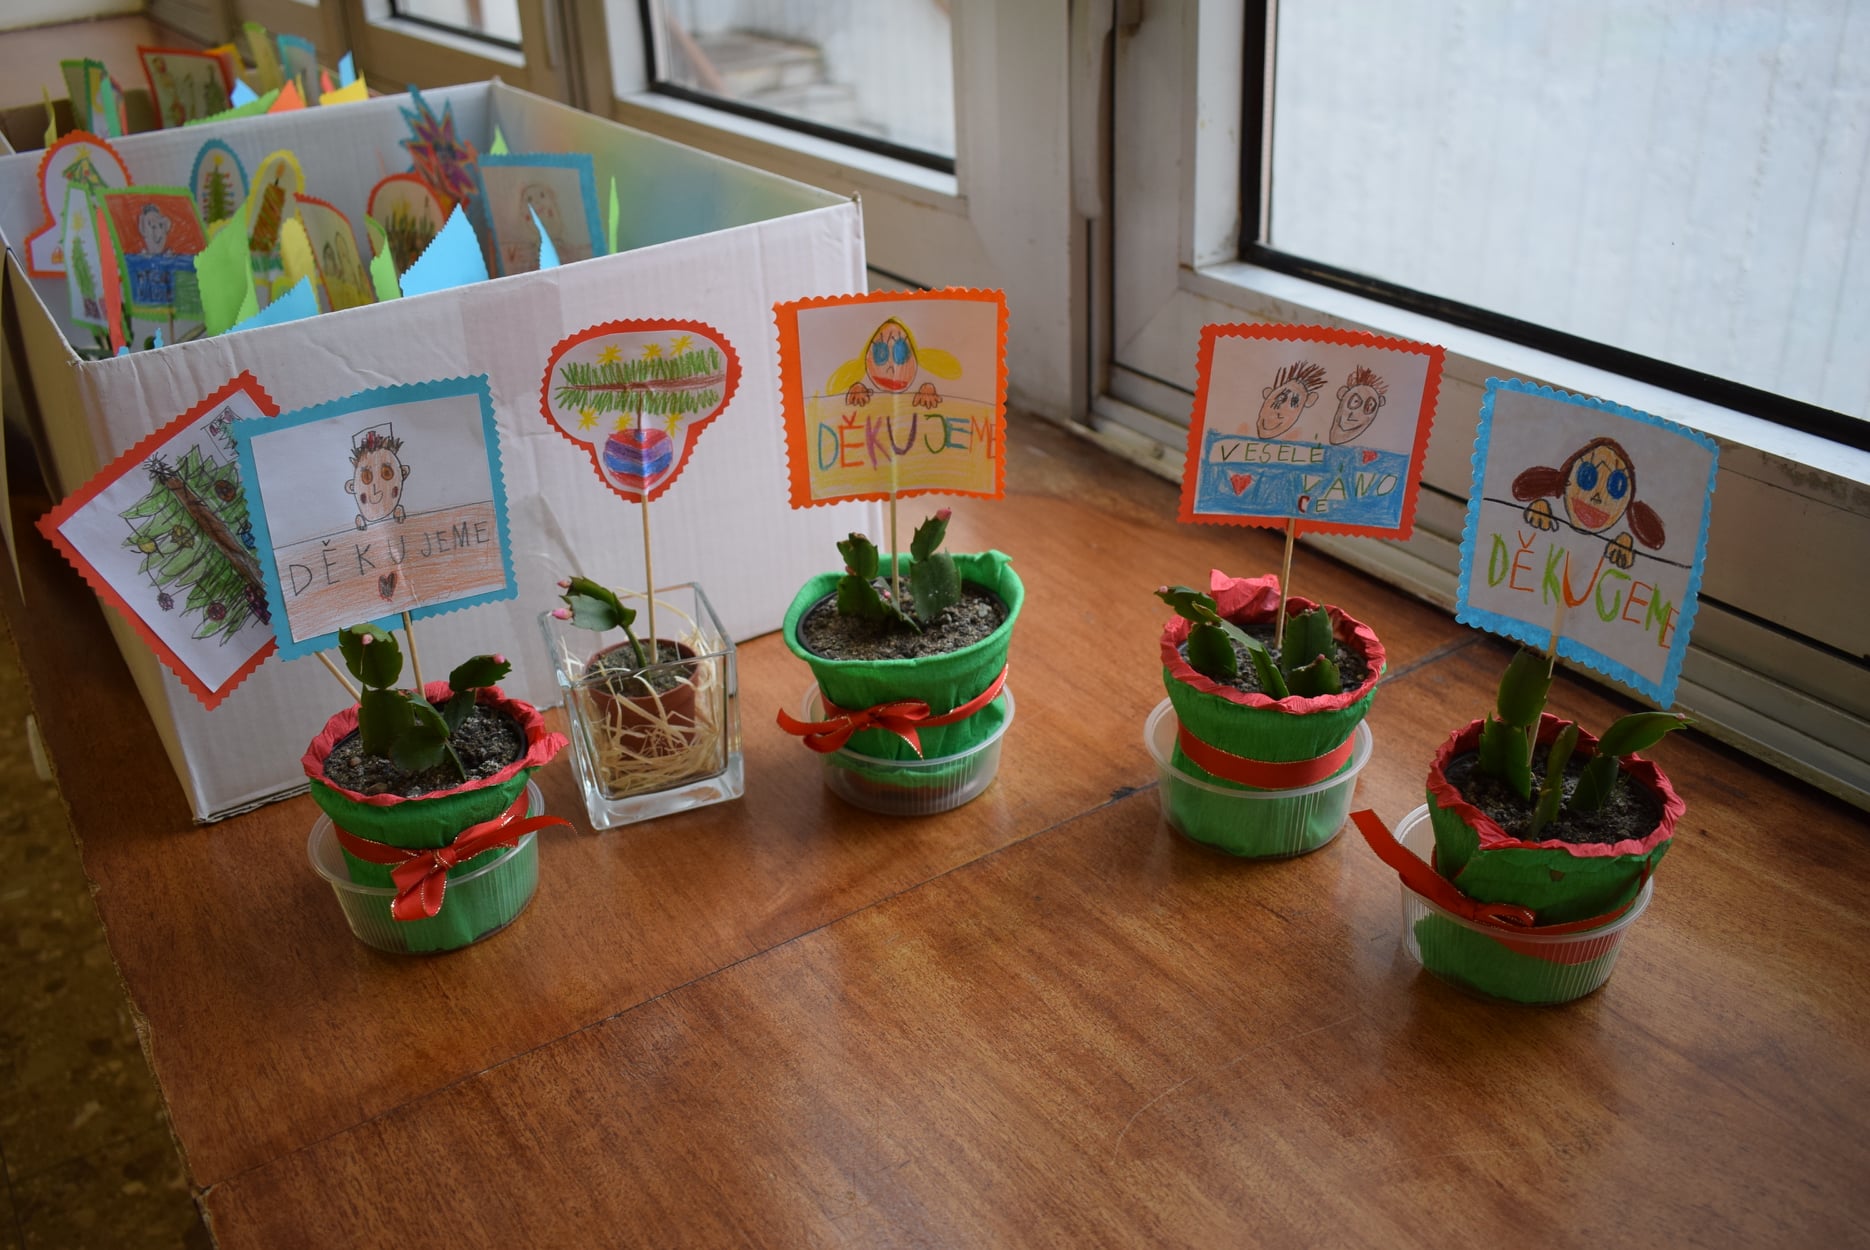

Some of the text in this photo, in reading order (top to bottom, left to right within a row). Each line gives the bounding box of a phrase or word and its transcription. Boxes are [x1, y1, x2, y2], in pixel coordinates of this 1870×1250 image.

[817, 411, 996, 471] DĚKUJEME
[1220, 433, 1324, 464] VESELÉ
[1303, 463, 1398, 500] VÁNO
[289, 520, 490, 597] DĚKUJEME
